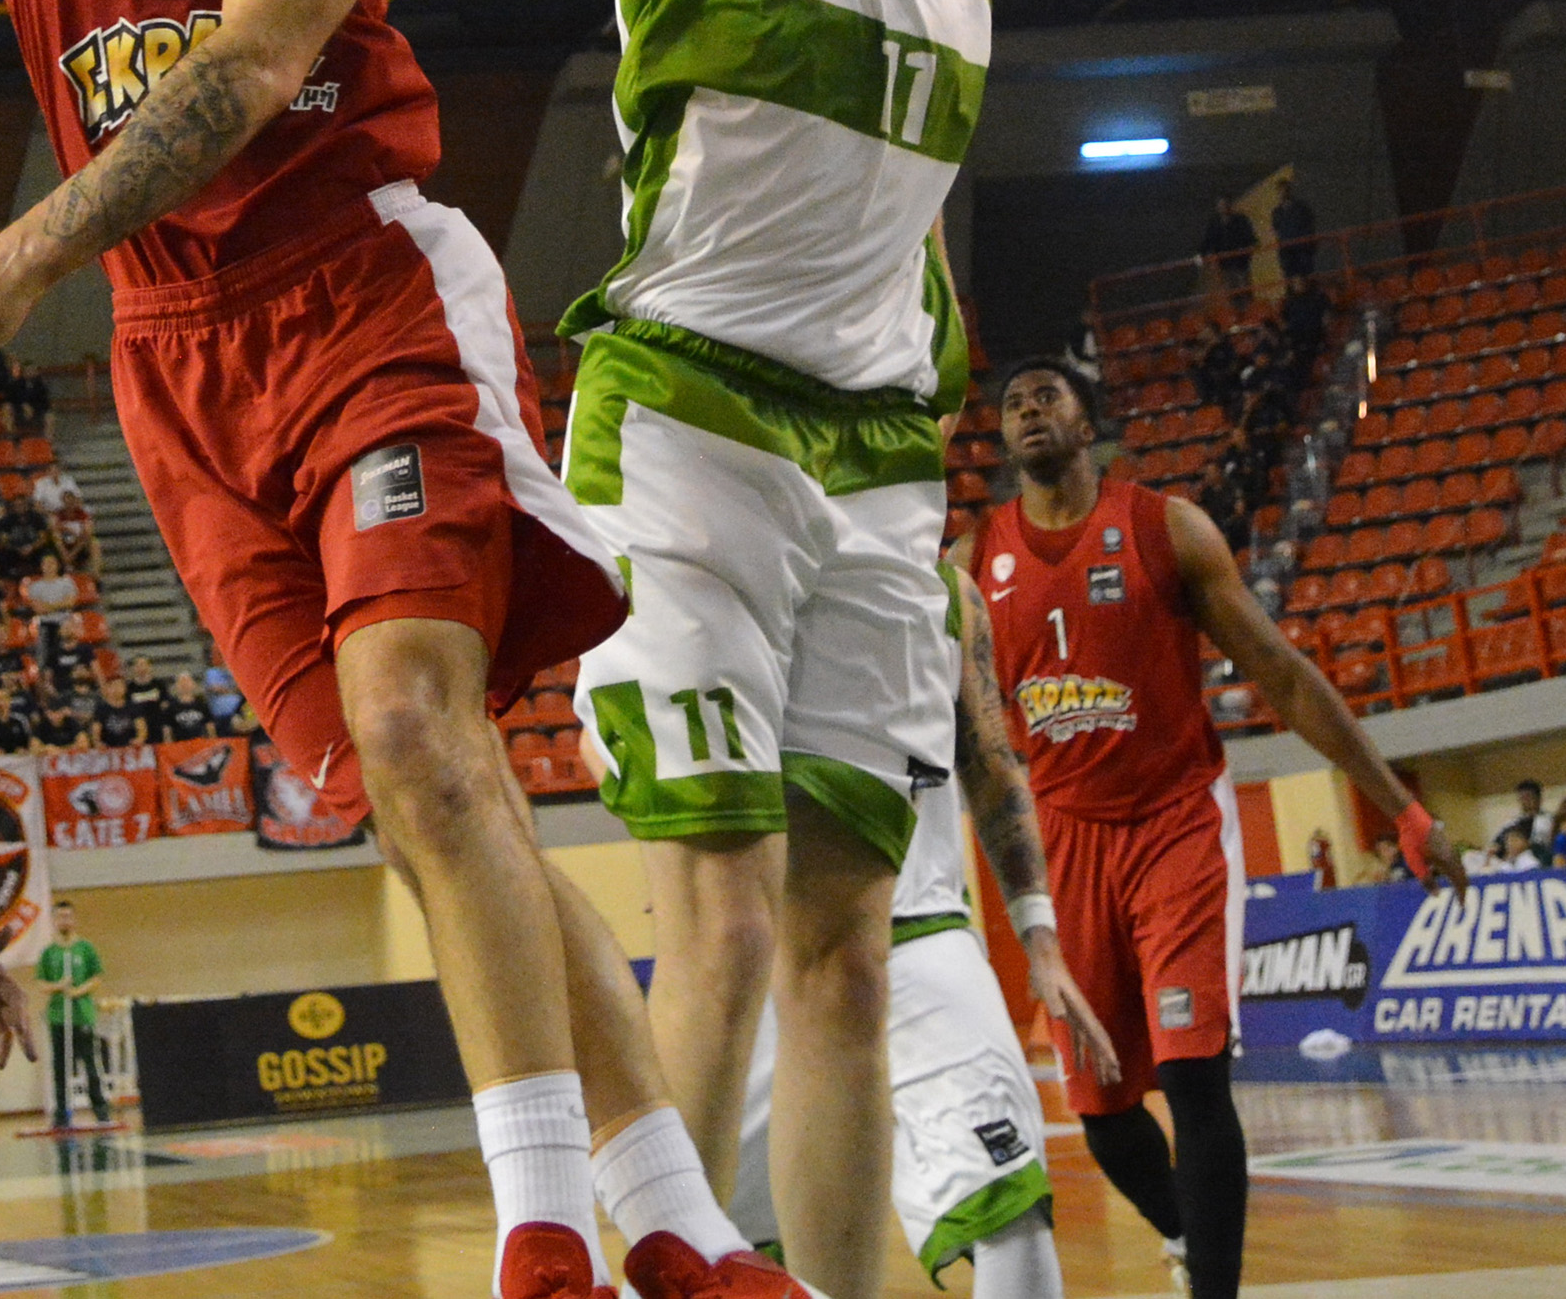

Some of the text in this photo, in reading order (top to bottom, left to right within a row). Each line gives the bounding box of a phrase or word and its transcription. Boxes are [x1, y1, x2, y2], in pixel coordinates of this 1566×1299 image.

[1047, 607, 1069, 661] 1
[669, 687, 747, 762] 11
[1374, 996, 1444, 1034] CAR
[257, 1042, 388, 1091] GOSSIP
